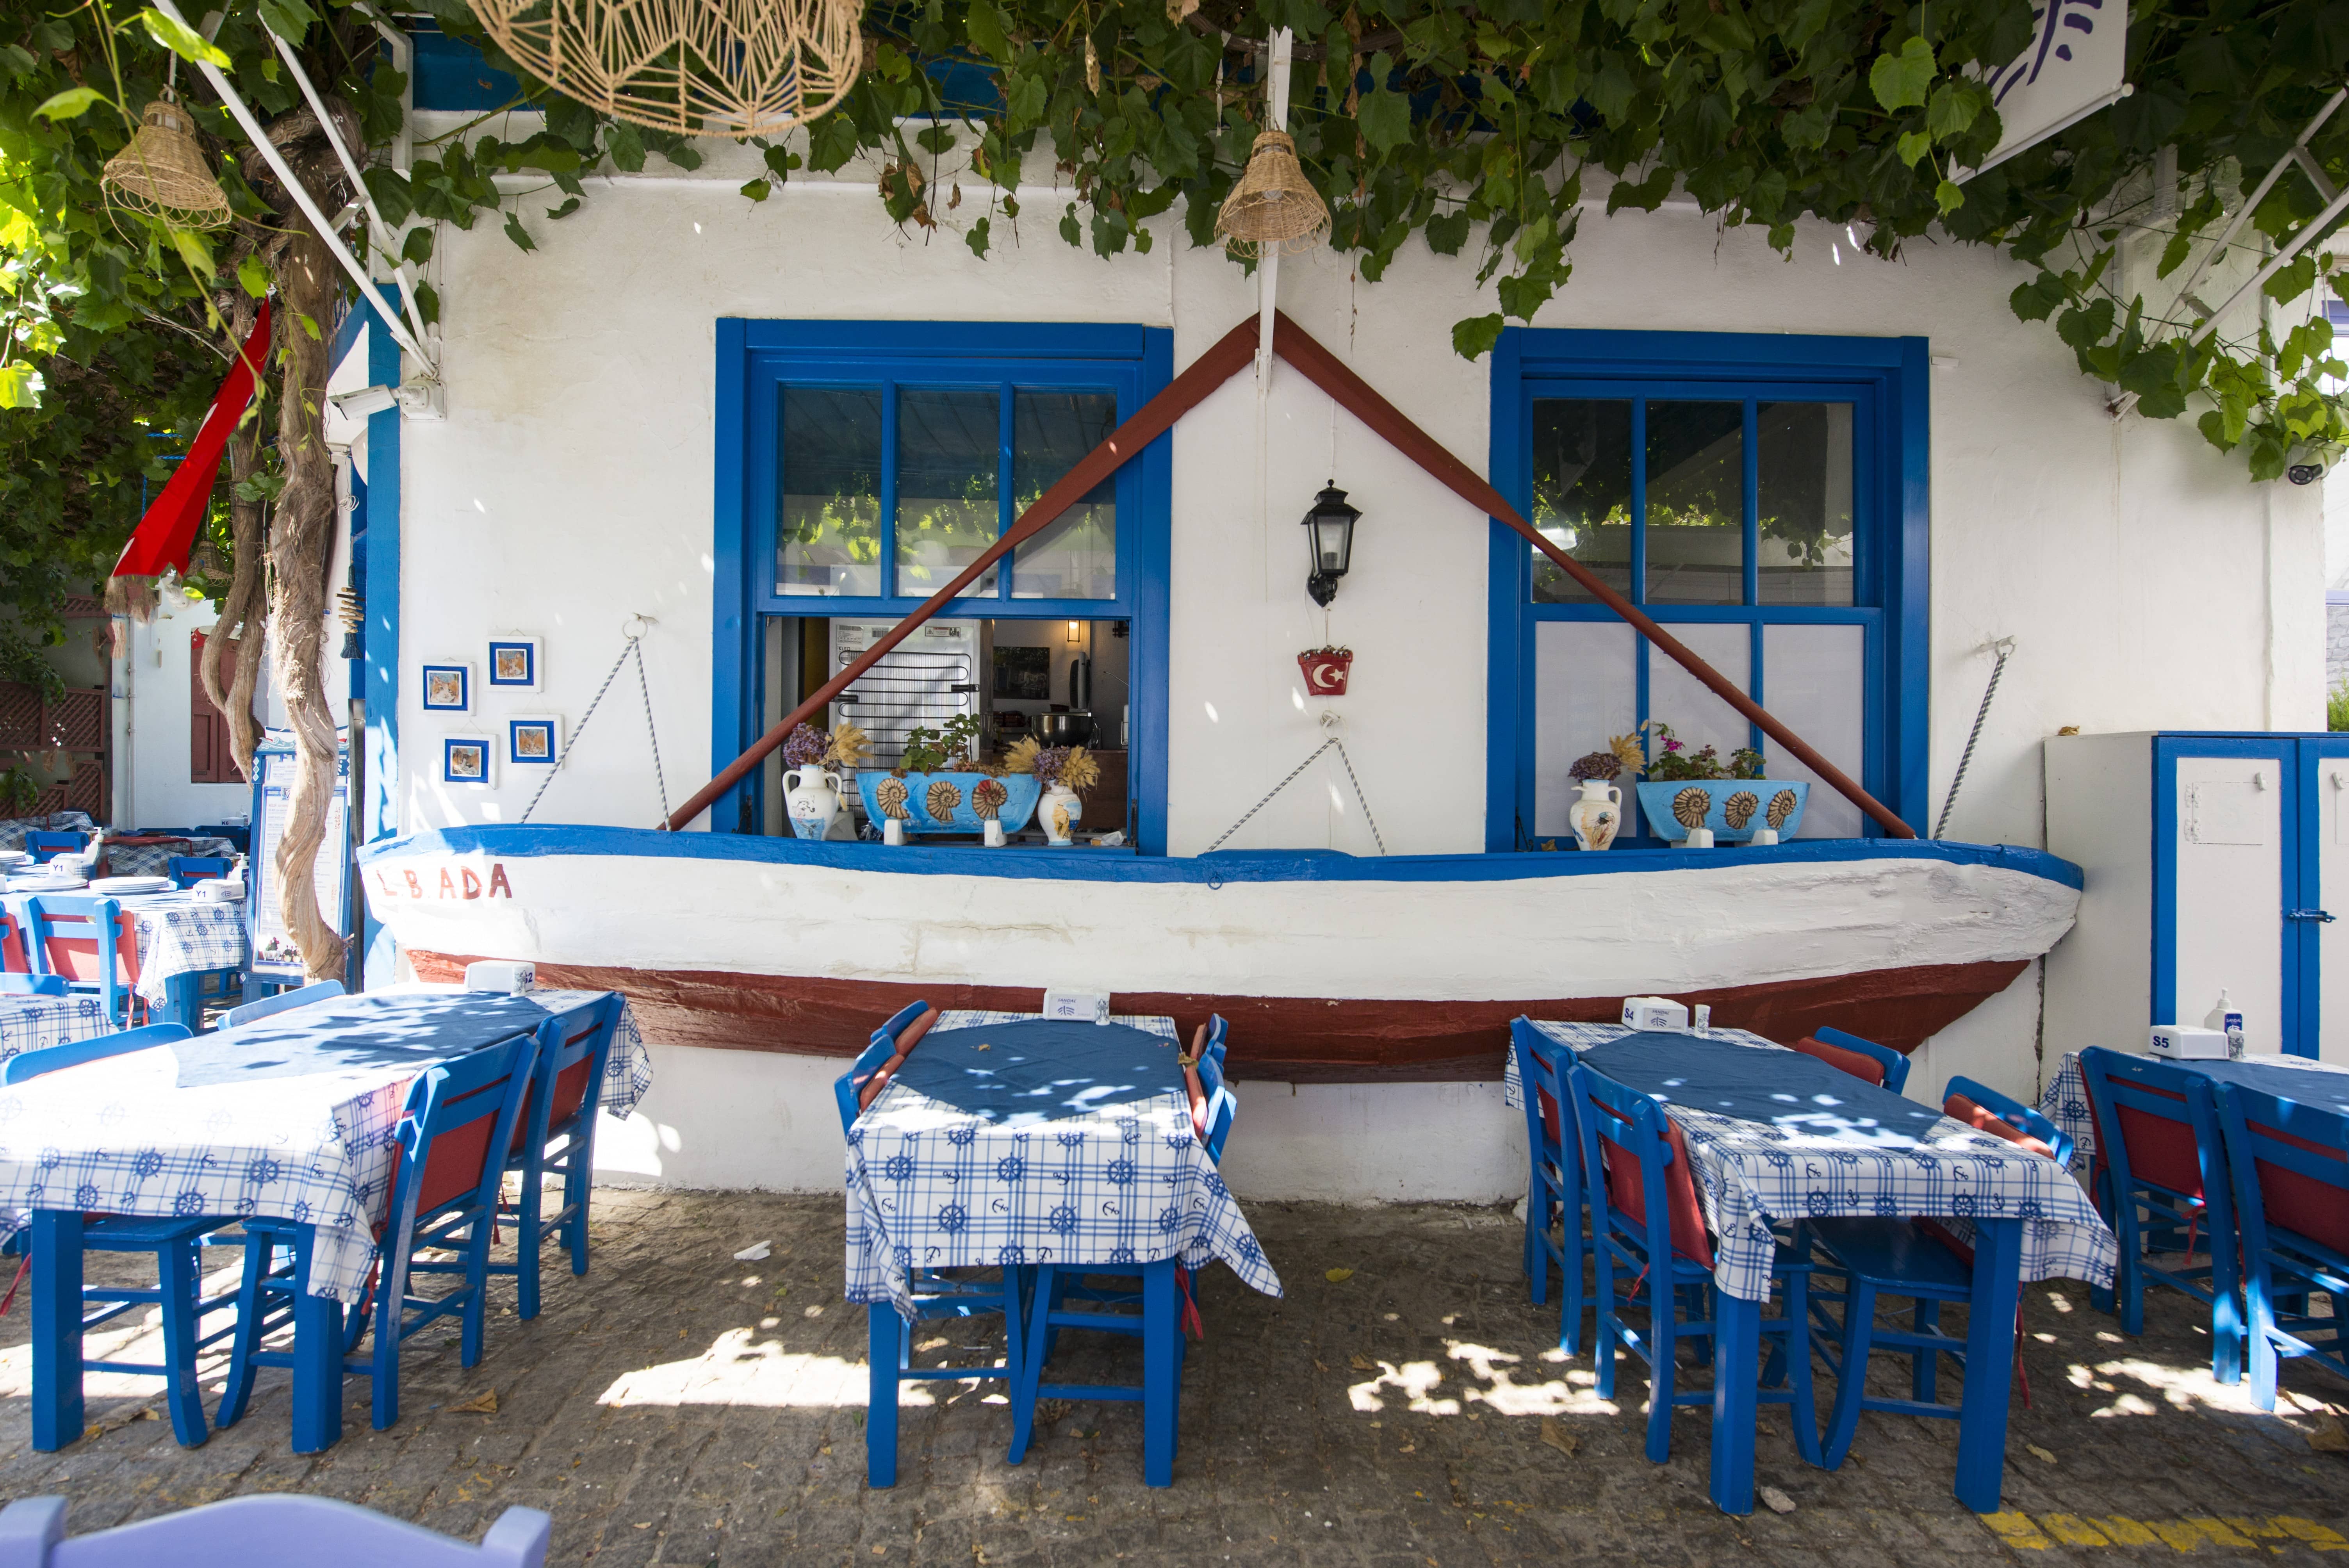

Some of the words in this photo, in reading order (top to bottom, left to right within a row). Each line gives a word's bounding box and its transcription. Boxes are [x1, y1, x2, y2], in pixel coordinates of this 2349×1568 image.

[439, 863, 512, 900] ADA
[1624, 1007, 1634, 1021] S4
[2153, 1035, 2169, 1048] S5
